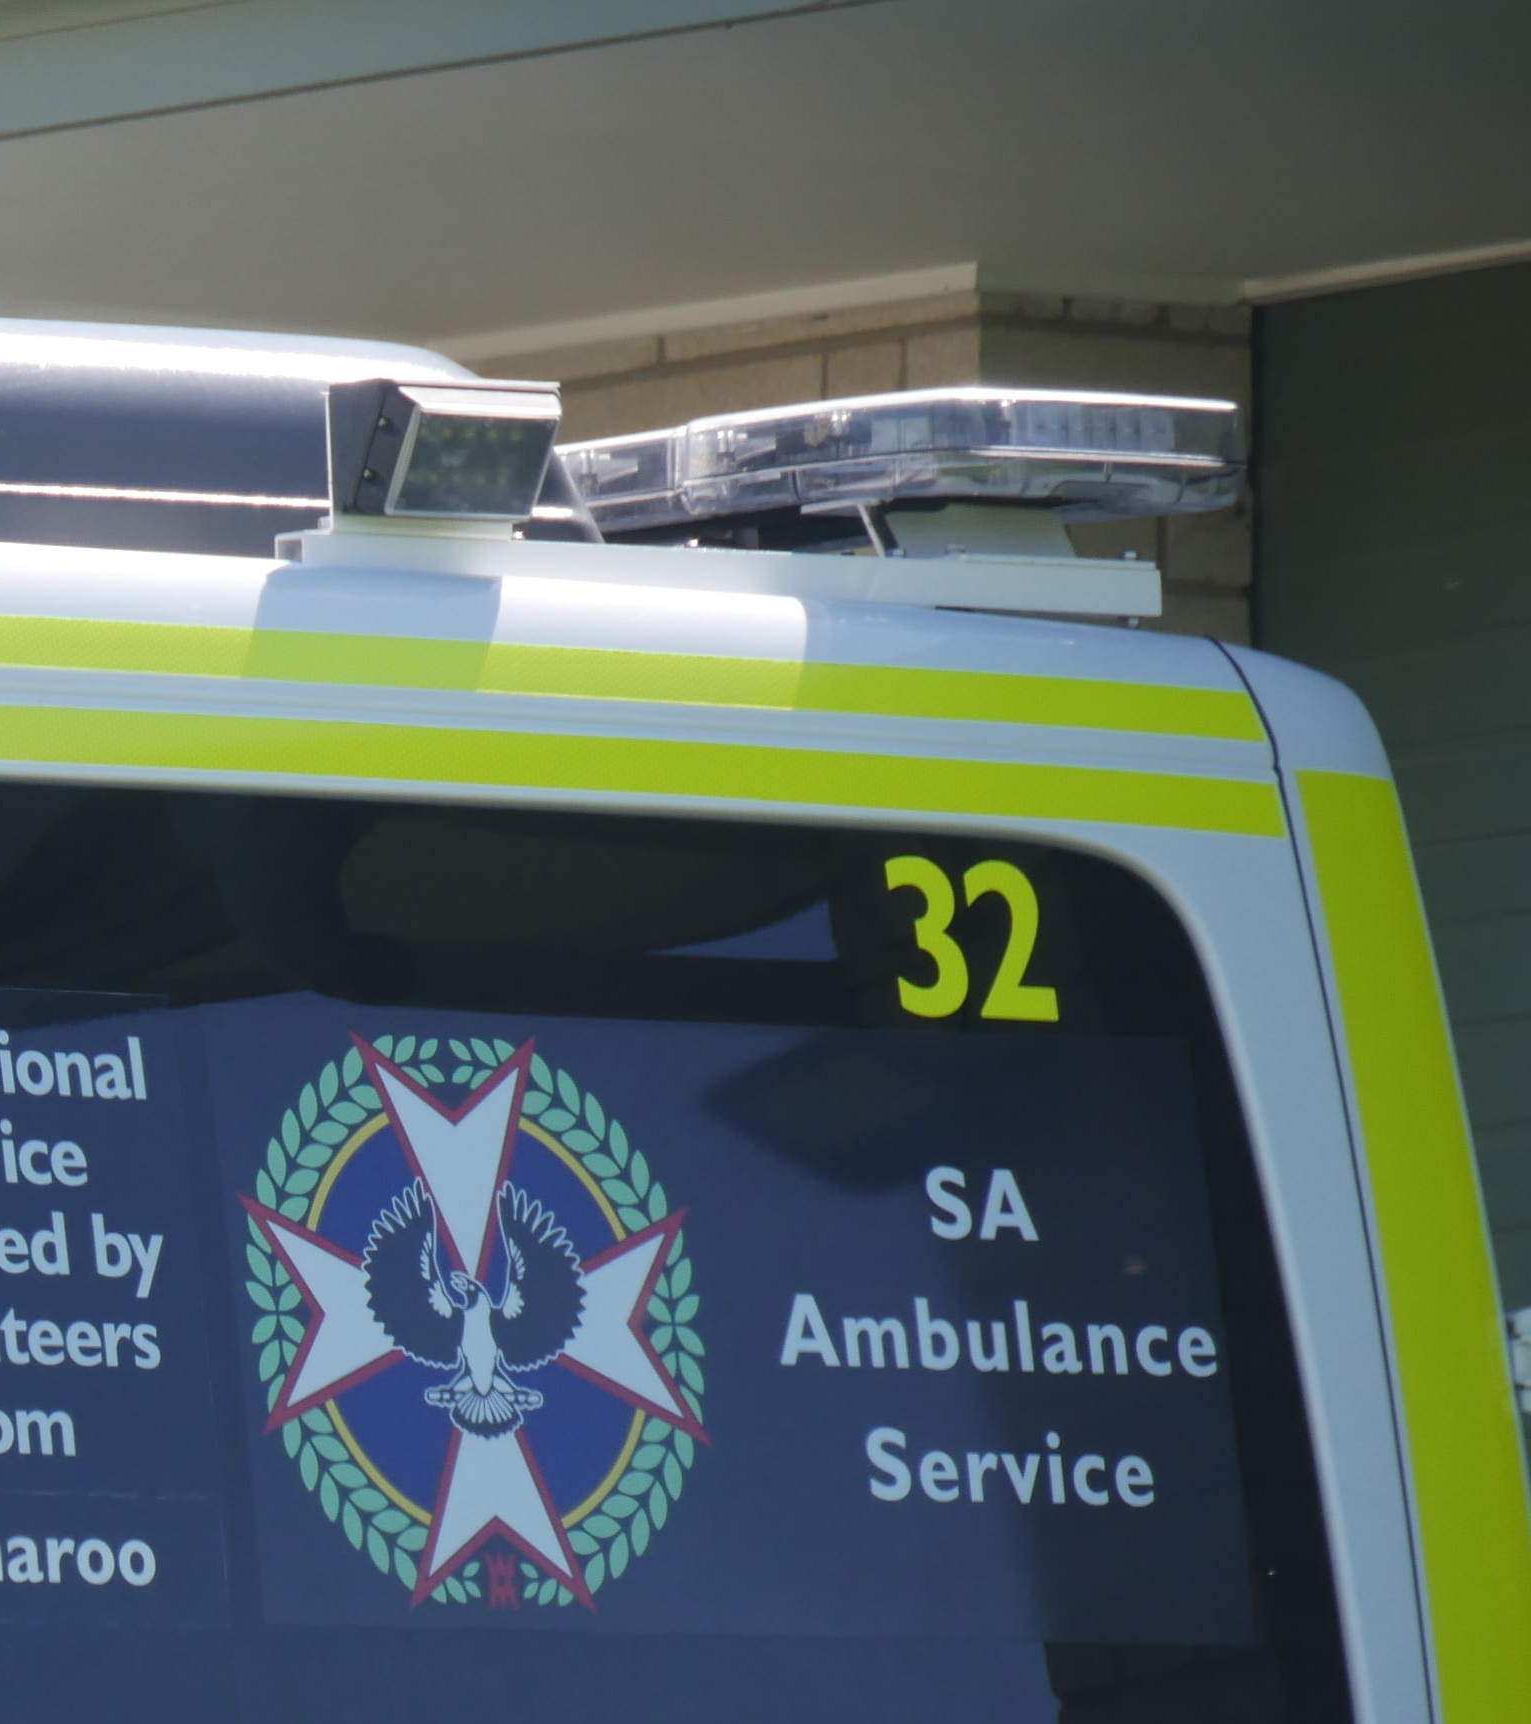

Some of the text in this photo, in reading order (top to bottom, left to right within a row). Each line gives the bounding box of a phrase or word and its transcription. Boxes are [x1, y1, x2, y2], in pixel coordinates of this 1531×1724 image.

[884, 855, 1059, 1022] 32
[925, 1166, 1039, 1242] SA
[91, 1213, 164, 1299] by
[780, 1293, 1218, 1377] Ambulance
[865, 1426, 1155, 1507] Service
